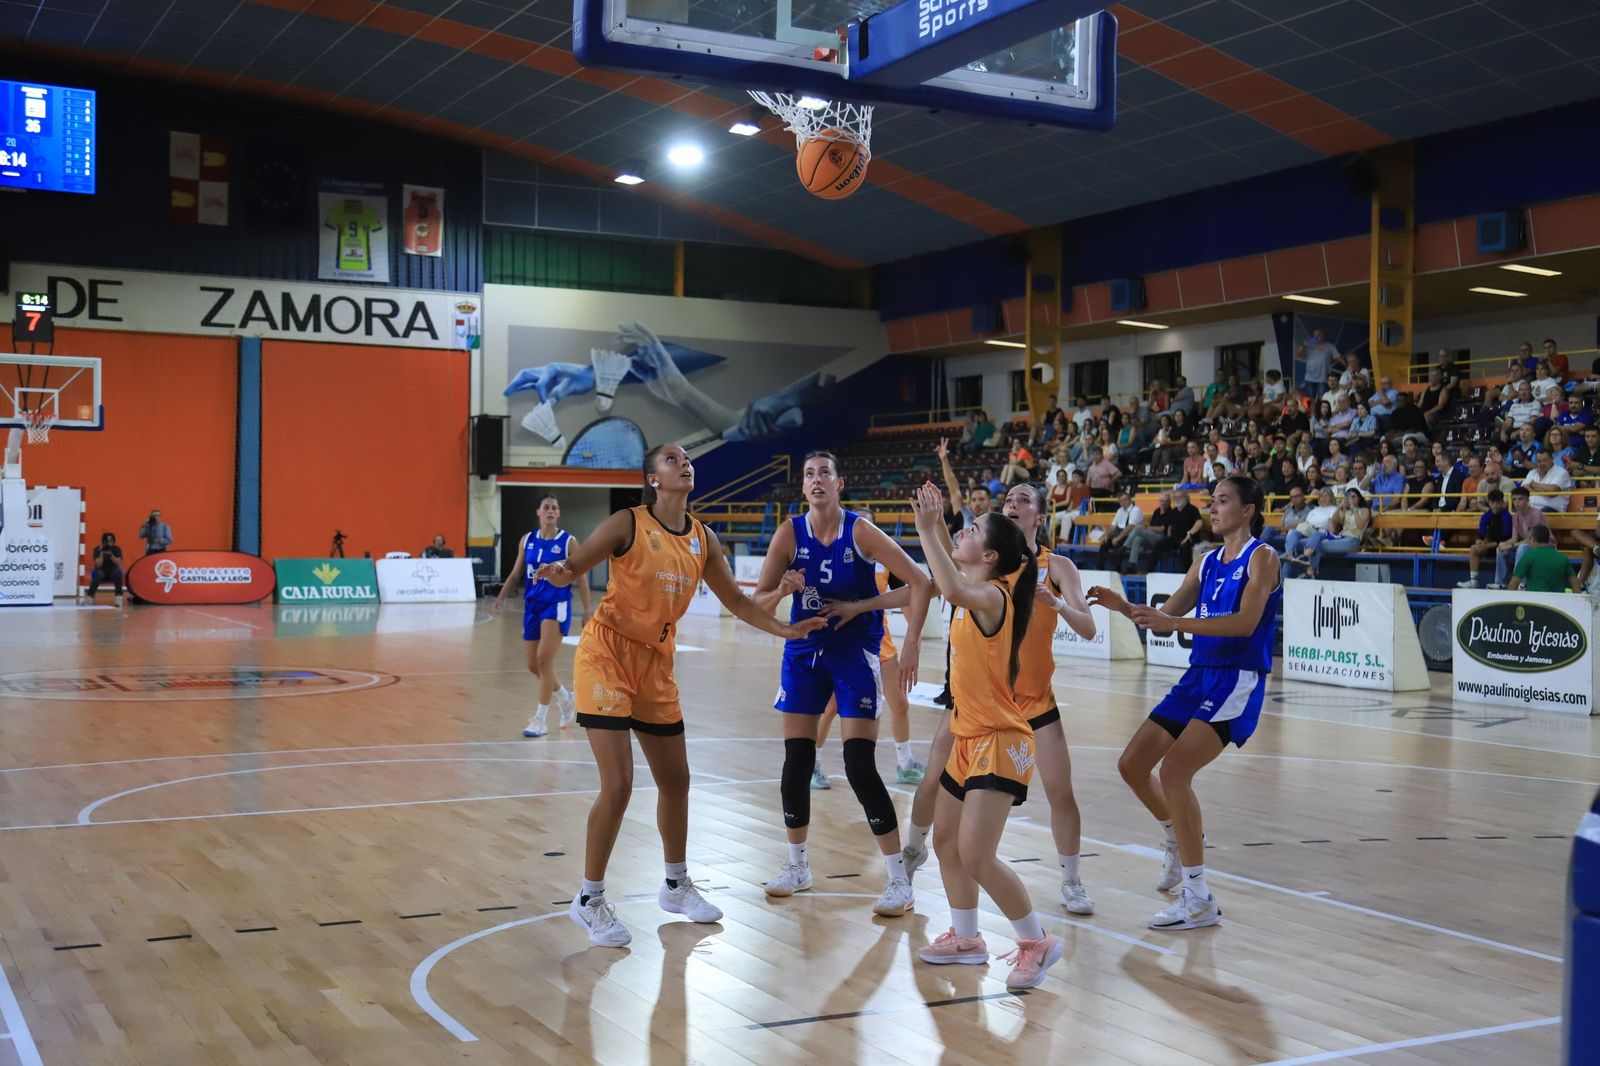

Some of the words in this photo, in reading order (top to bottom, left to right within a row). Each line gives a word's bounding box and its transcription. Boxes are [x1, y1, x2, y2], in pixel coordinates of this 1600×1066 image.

[919, 0, 988, 38] Sports
[349, 221, 358, 238] 9
[22, 294, 49, 305] 6:14
[48, 276, 123, 322] DE
[200, 286, 439, 340] ZAMORA
[25, 312, 41, 331] 7
[6, 544, 48, 553] breros
[537, 548, 543, 563] 1
[228, 574, 249, 582] LEÓN
[820, 559, 832, 584] 5
[281, 586, 322, 600] CAJA
[322, 586, 376, 599] RURAL
[1212, 578, 1226, 601] 7
[660, 622, 671, 643] 5
[1468, 616, 1522, 647] Paulino
[1529, 620, 1580, 653] Iglesias
[1150, 639, 1175, 649] GIMNASIO
[1288, 645, 1360, 667] HERBI-PLAST,
[1365, 654, 1385, 668] S.L.
[1487, 651, 1519, 661] Embutidos
[1525, 655, 1553, 664] Jamones
[1288, 661, 1385, 681] SEÑALIZACIONES
[1458, 681, 1587, 706] www.paulinoiglesias.com
